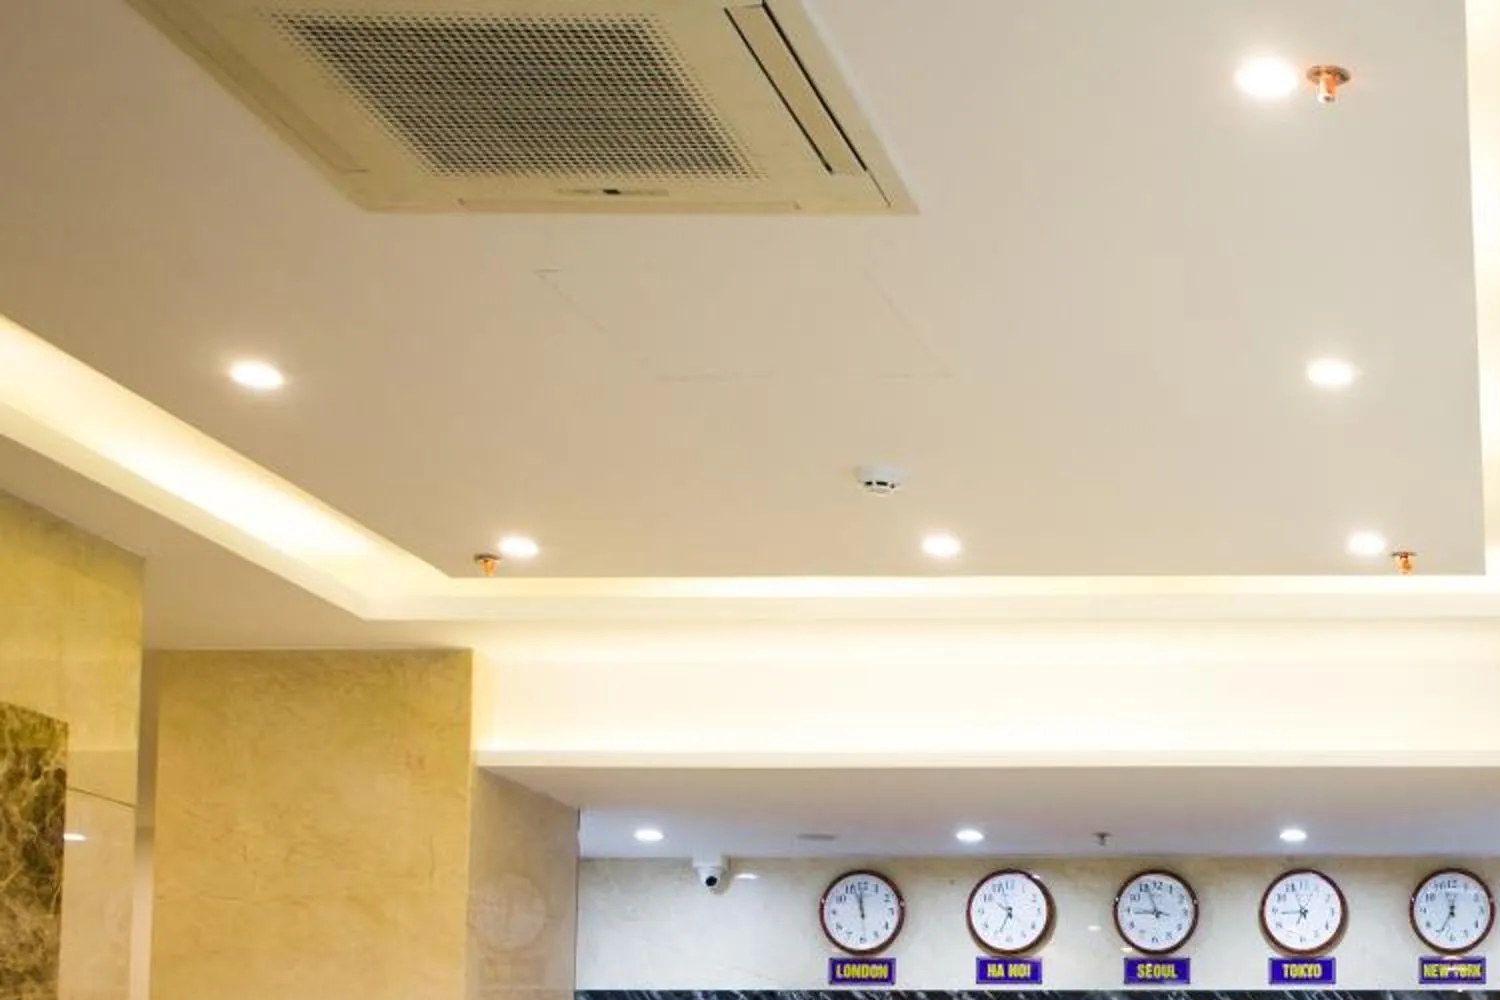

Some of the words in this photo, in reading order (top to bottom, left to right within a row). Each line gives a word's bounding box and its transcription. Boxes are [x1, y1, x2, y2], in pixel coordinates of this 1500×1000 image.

[836, 964, 889, 979] LONDON
[987, 964, 1004, 978] HA
[1008, 964, 1031, 978] NOI
[1136, 964, 1178, 978] SEOUL
[1282, 963, 1322, 978] TOKYO
[1423, 964, 1449, 977] NEW
